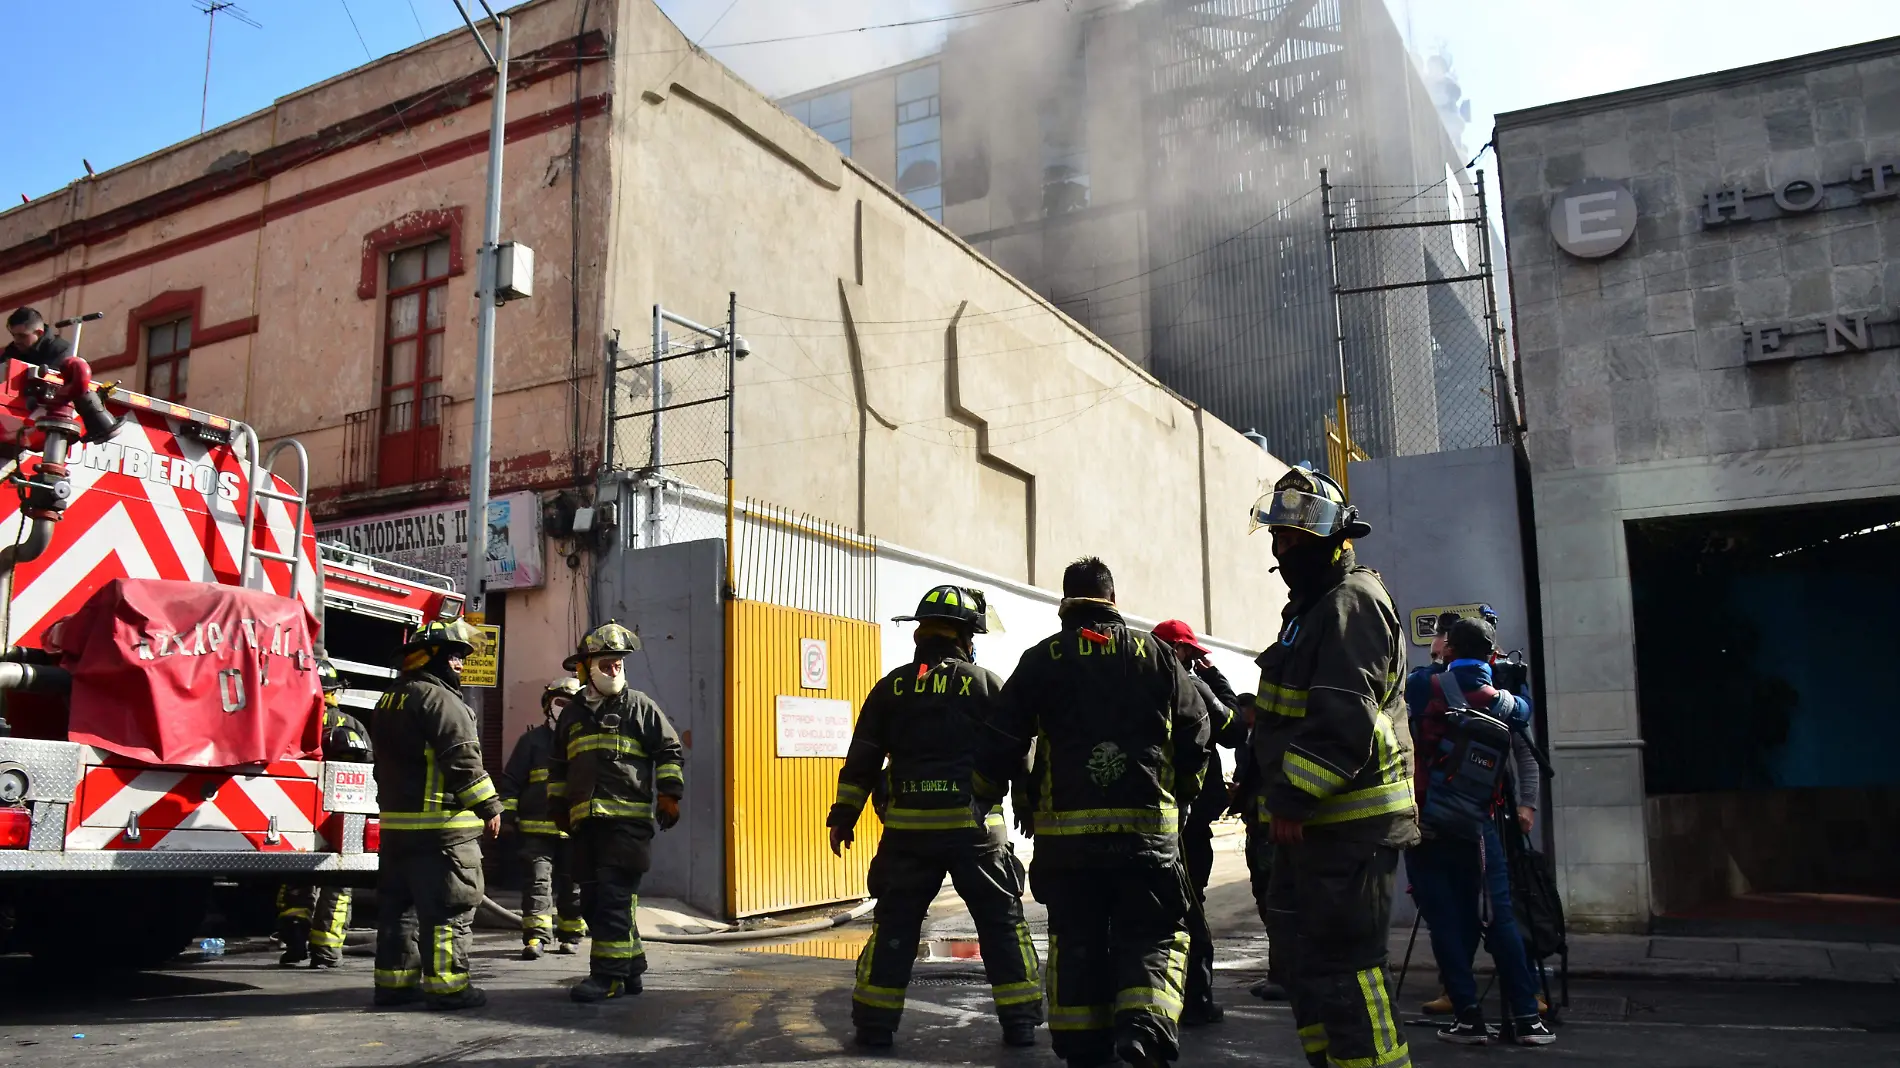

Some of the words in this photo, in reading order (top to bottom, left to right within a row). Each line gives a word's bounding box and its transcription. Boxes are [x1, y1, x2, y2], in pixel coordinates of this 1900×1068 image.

[1565, 190, 1622, 244] E
[64, 442, 240, 502] OMBEROS
[364, 513, 446, 555] MODERNAS
[1049, 635, 1148, 661] CDMX
[893, 673, 974, 696] CDMX
[336, 772, 364, 785] 911
[920, 779, 948, 792] GOMEZ
